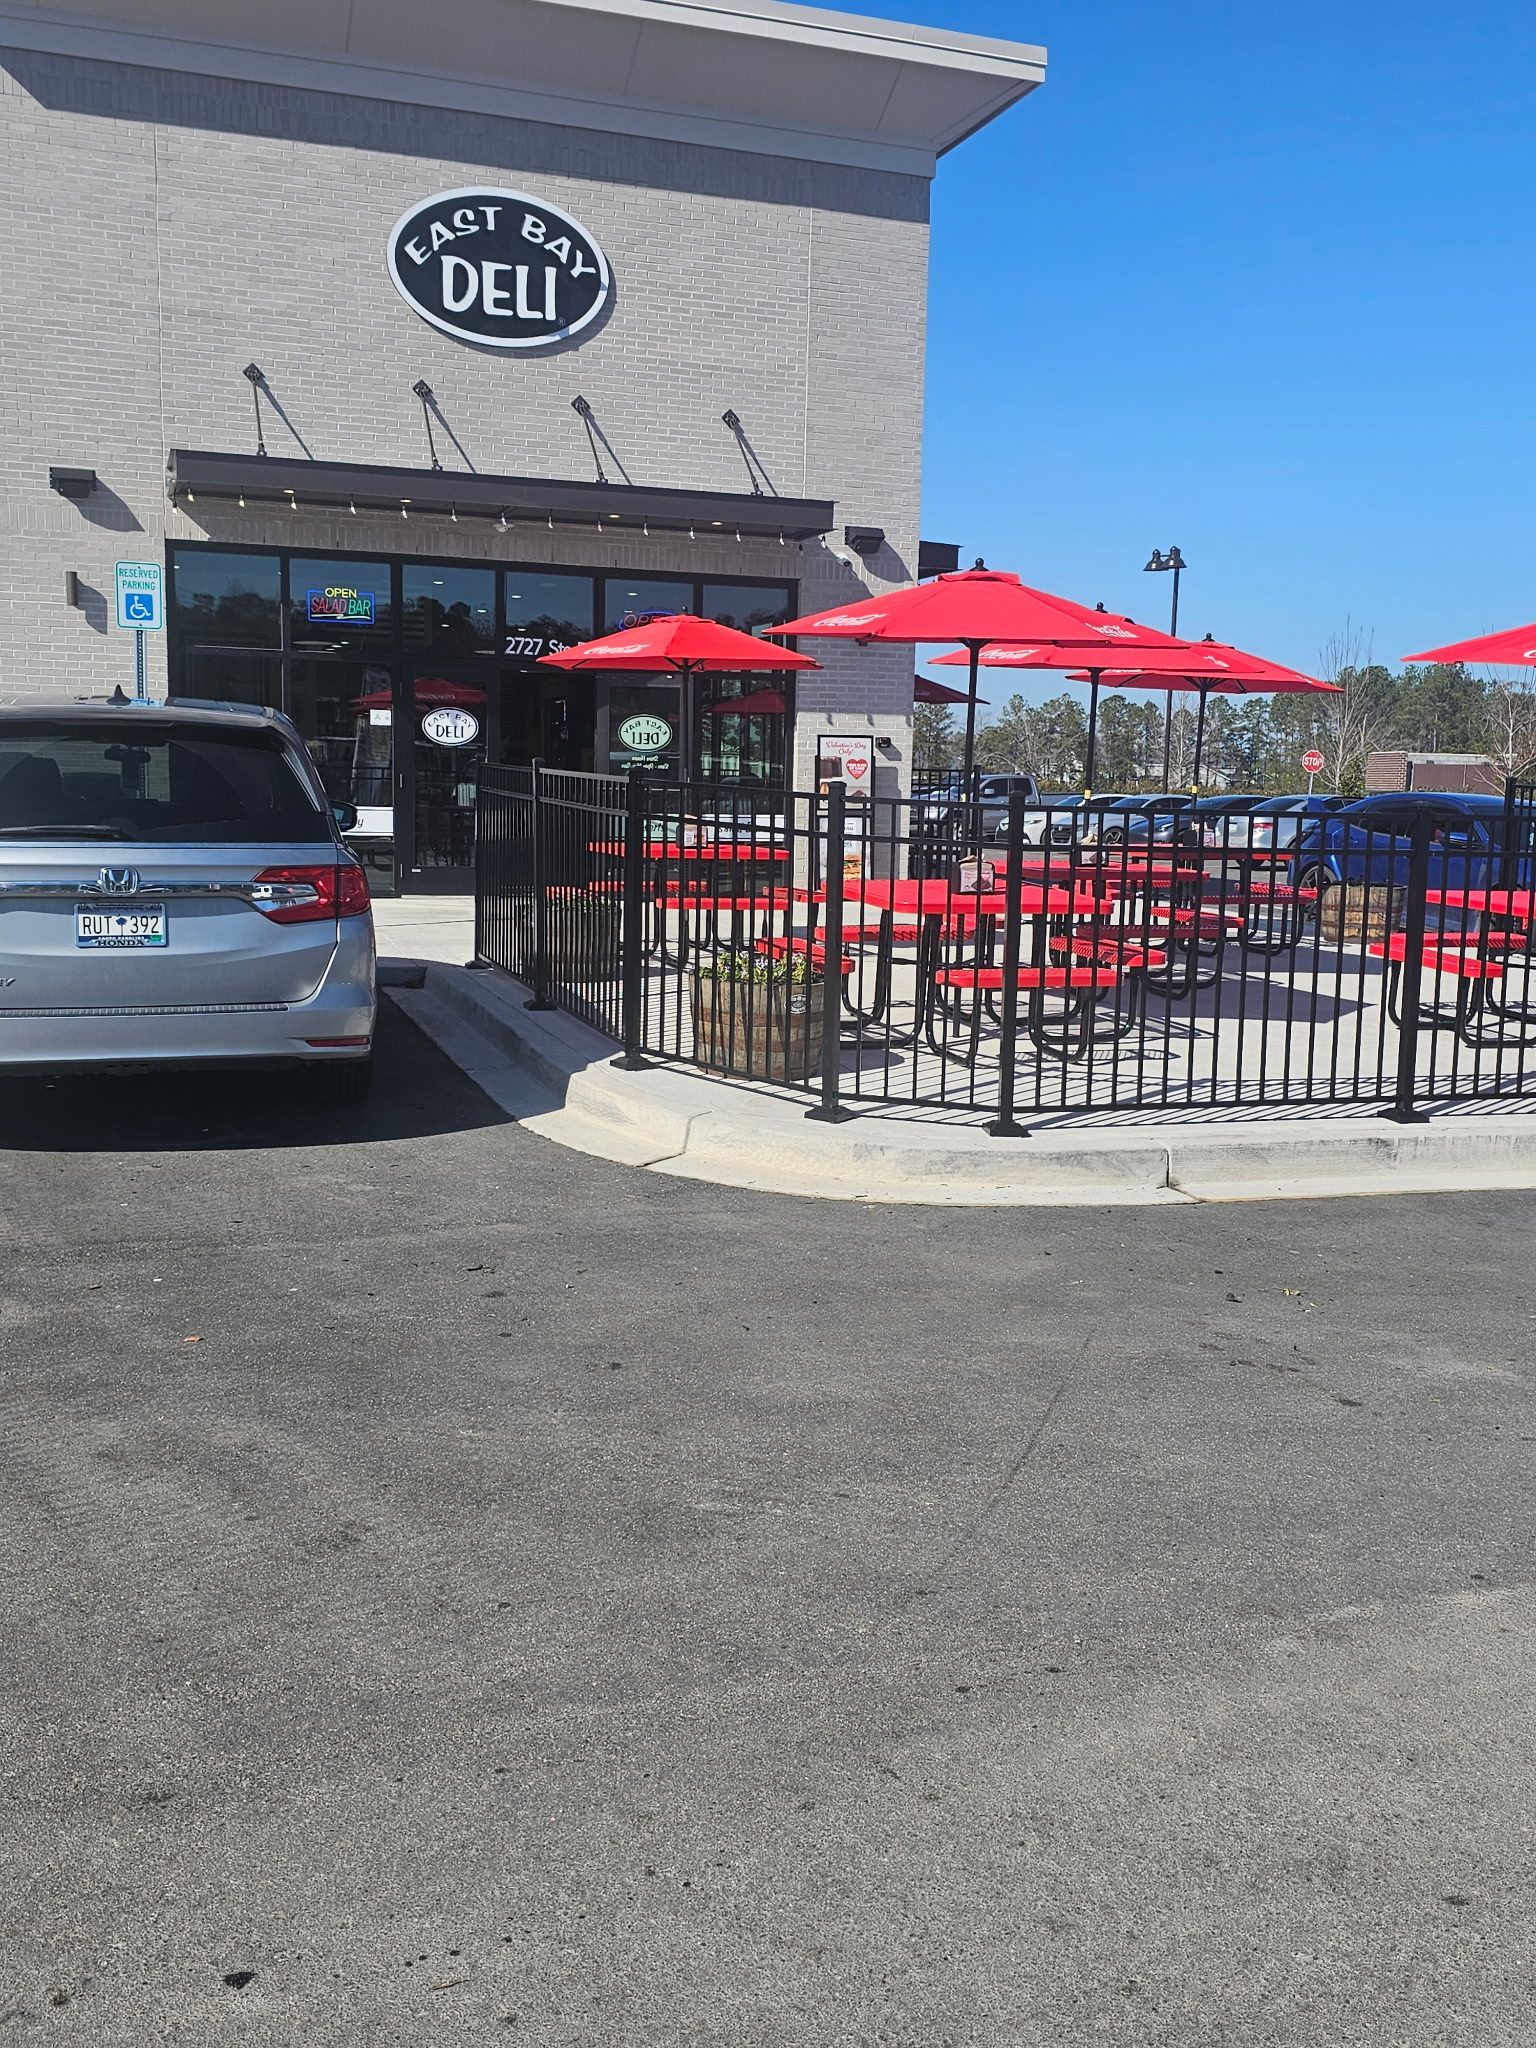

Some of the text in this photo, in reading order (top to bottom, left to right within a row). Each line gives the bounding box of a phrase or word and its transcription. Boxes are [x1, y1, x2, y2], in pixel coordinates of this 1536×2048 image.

[404, 206, 597, 278] EAST BAY
[441, 255, 557, 321] DELI
[119, 569, 158, 579] RESERVED
[122, 580, 156, 590] PARKING
[325, 587, 357, 598] OPEN
[311, 597, 371, 616] SALAD BAR
[505, 637, 543, 656] 2727
[436, 724, 464, 739] DELI
[1304, 757, 1323, 766] STOP
[83, 915, 159, 934] RUT 392
